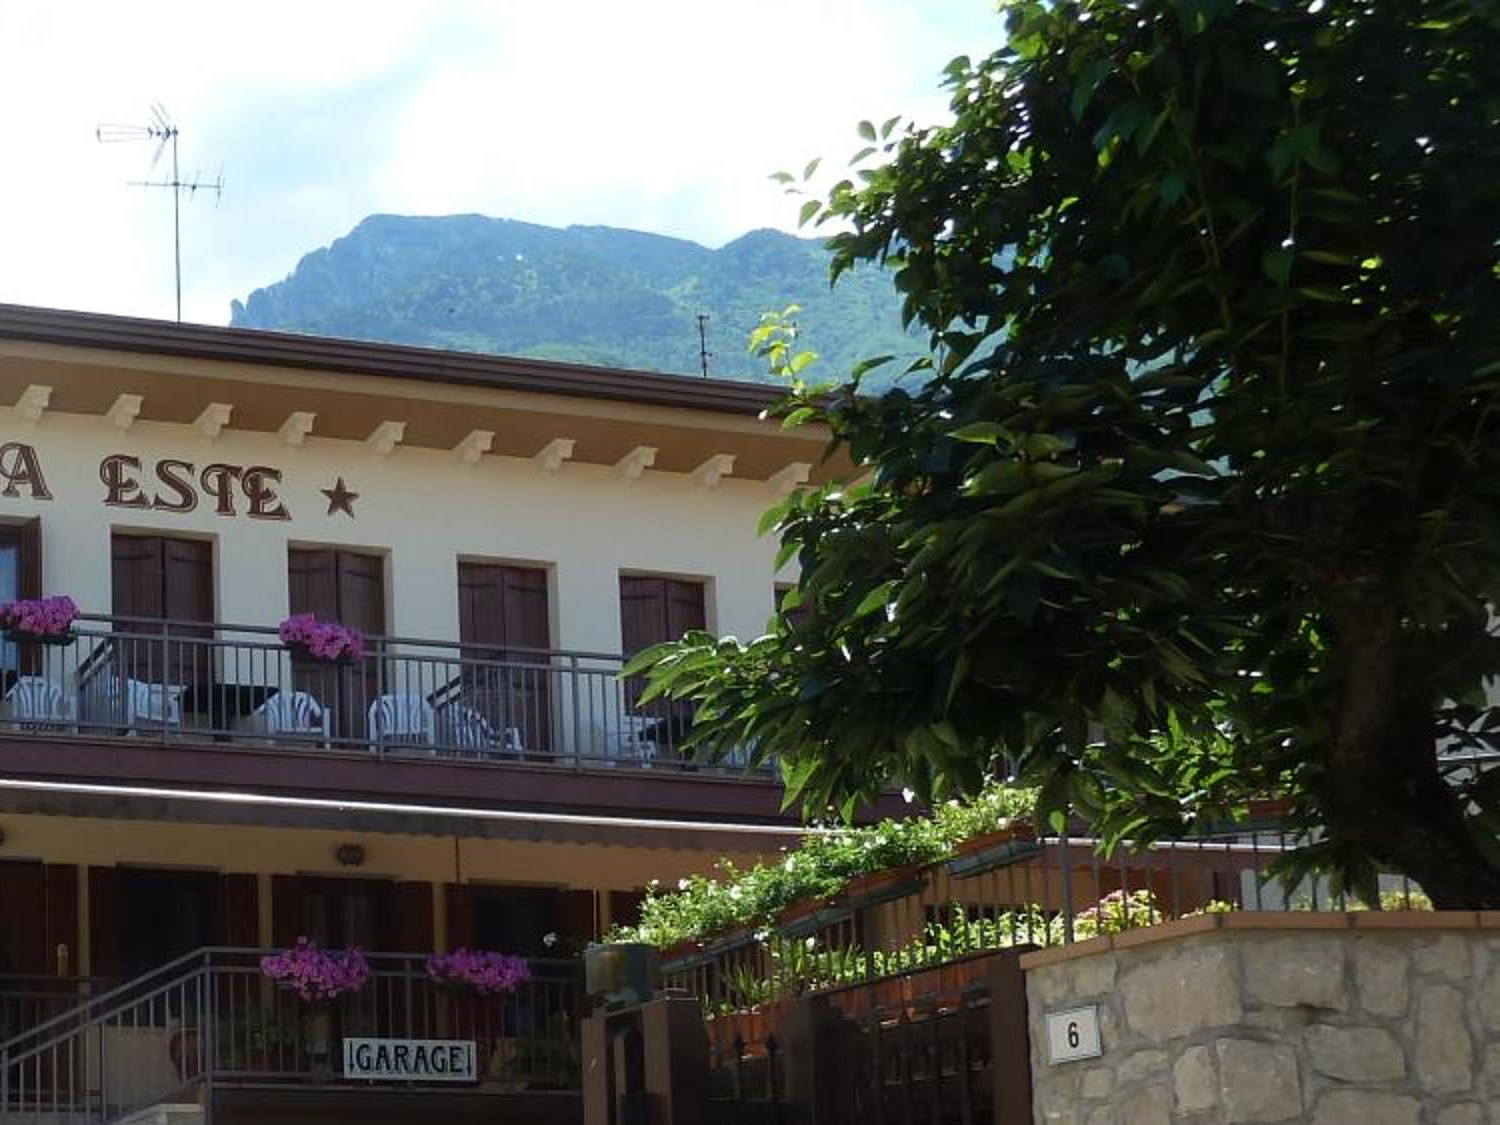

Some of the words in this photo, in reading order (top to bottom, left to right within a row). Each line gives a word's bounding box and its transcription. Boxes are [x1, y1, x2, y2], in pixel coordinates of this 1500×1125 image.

[100, 453, 292, 521] ESTE
[1067, 1022, 1079, 1048] 6
[356, 1044, 464, 1074] GARAGE
